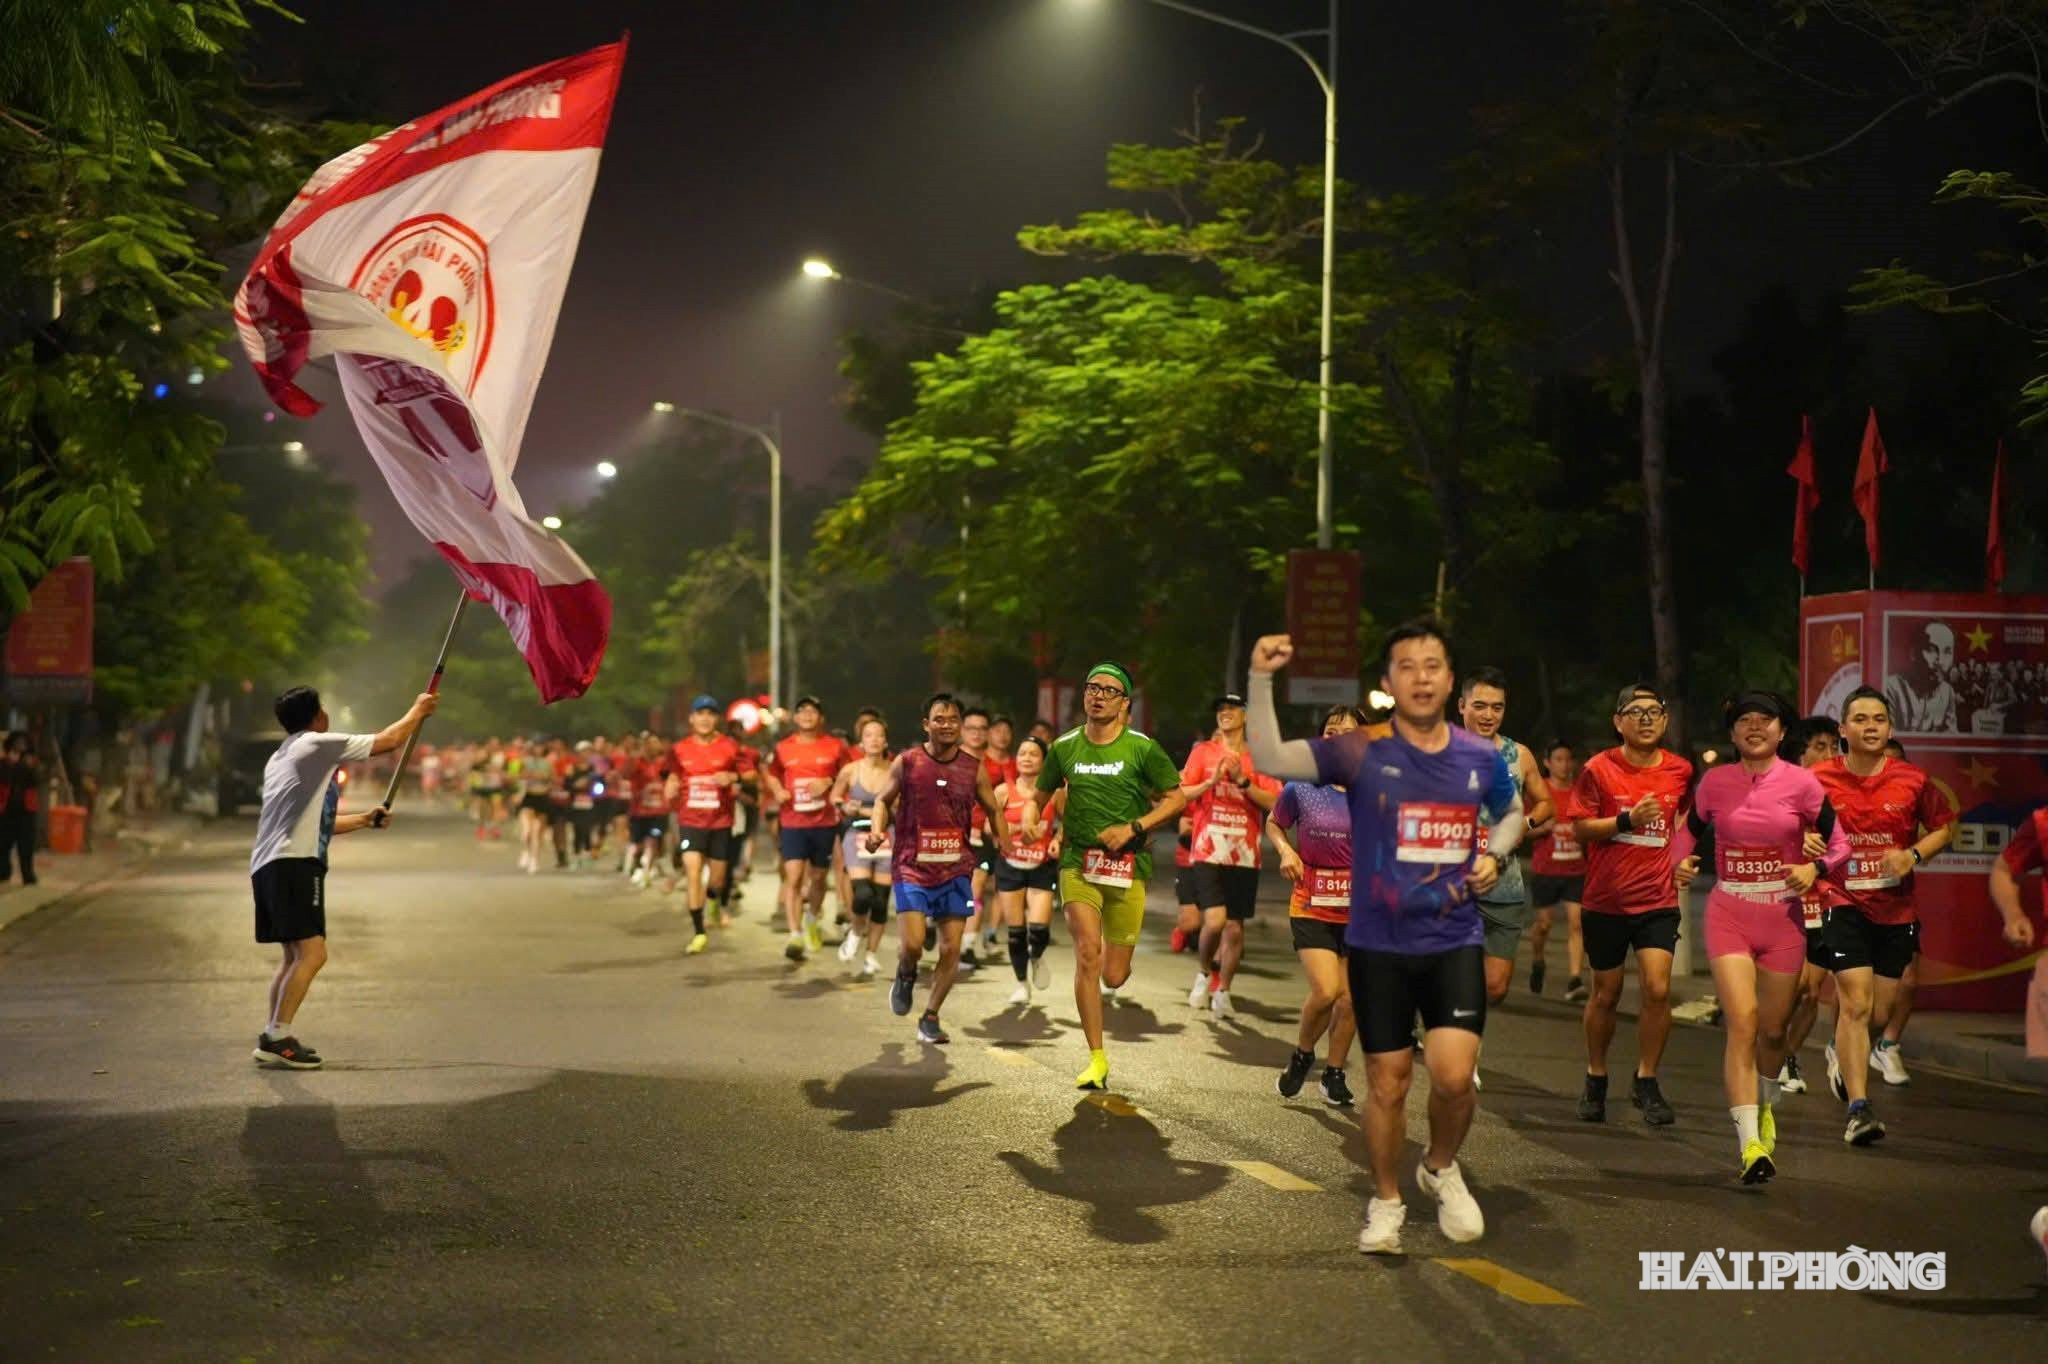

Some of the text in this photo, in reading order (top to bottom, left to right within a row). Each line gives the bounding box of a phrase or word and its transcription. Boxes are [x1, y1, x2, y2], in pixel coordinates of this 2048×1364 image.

[1074, 761, 1124, 776] Herbalife
[1420, 821, 1473, 839] 81903
[930, 838, 960, 849] 81956
[1097, 858, 1132, 873] 82854
[1736, 859, 1782, 874] 83302
